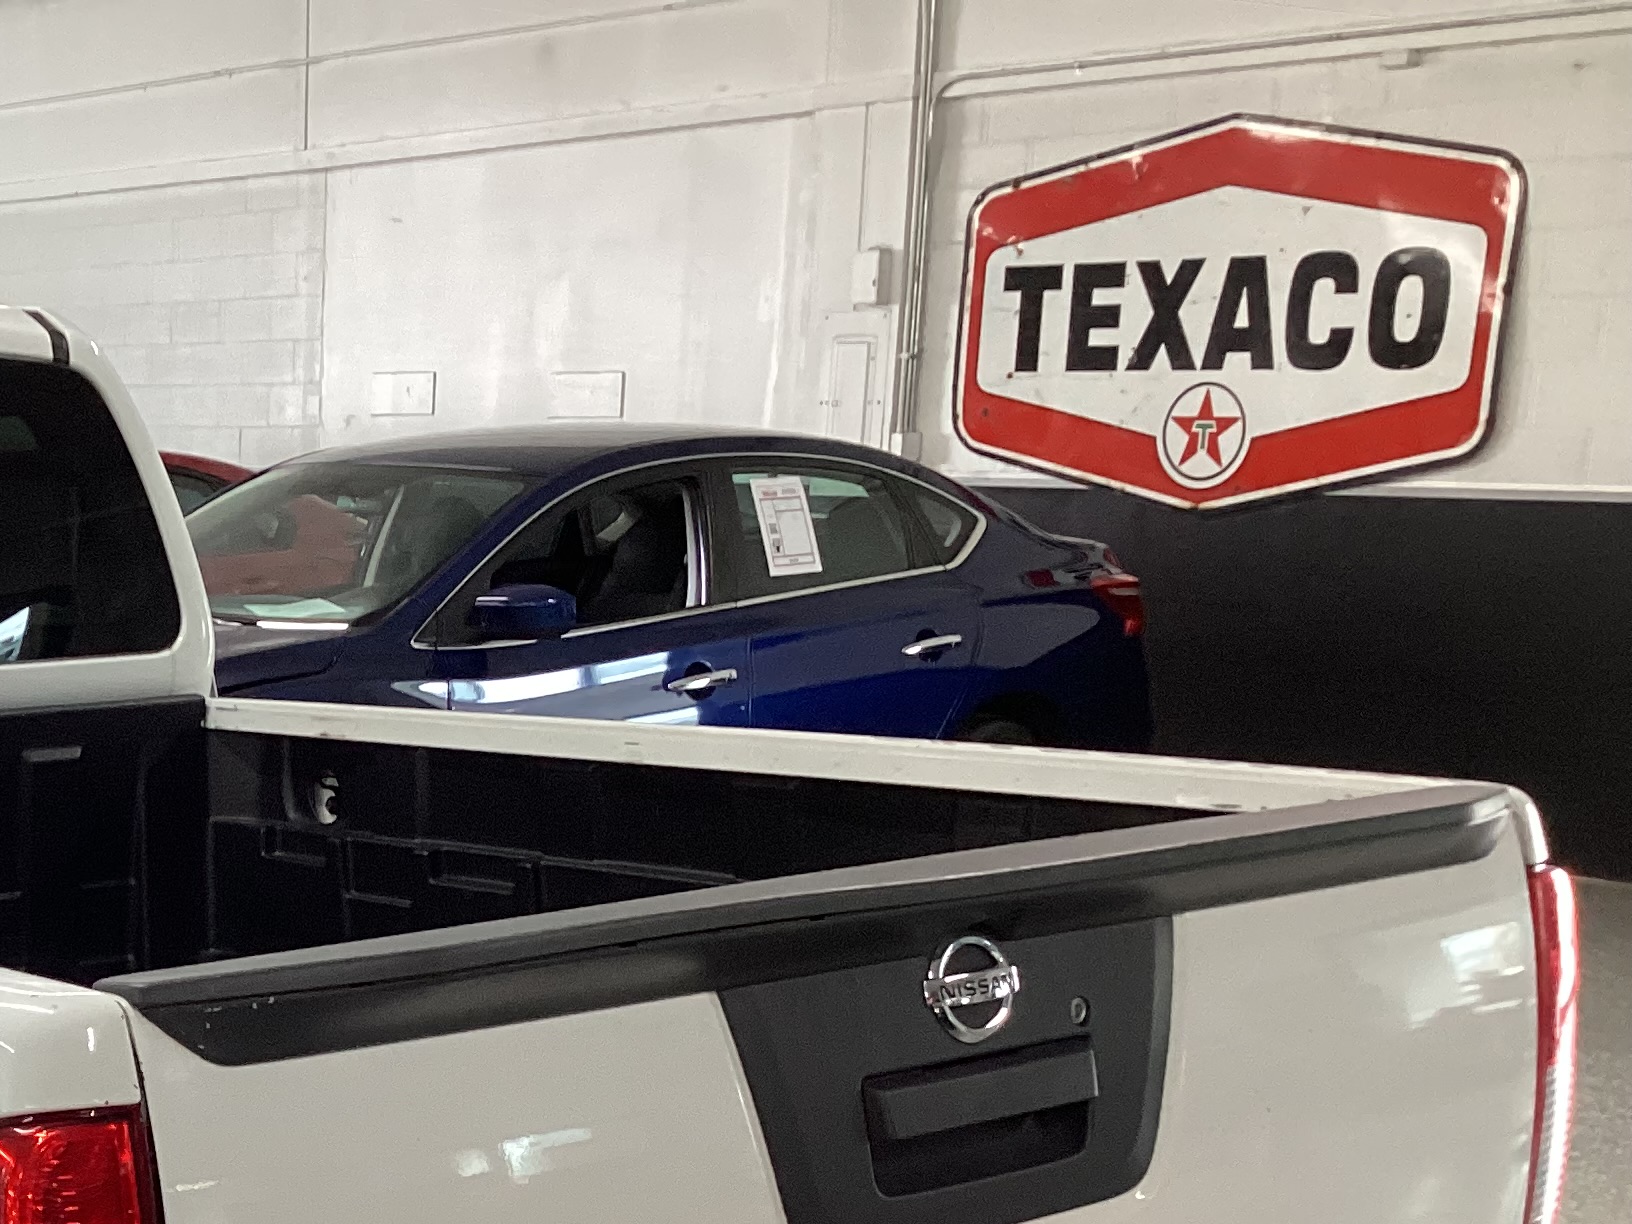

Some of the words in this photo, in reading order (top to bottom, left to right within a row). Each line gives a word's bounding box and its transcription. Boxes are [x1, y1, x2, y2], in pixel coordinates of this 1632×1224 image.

[1004, 247, 1451, 371] TEXACO
[1193, 422, 1215, 451] T
[940, 973, 1014, 999] NISSAN
